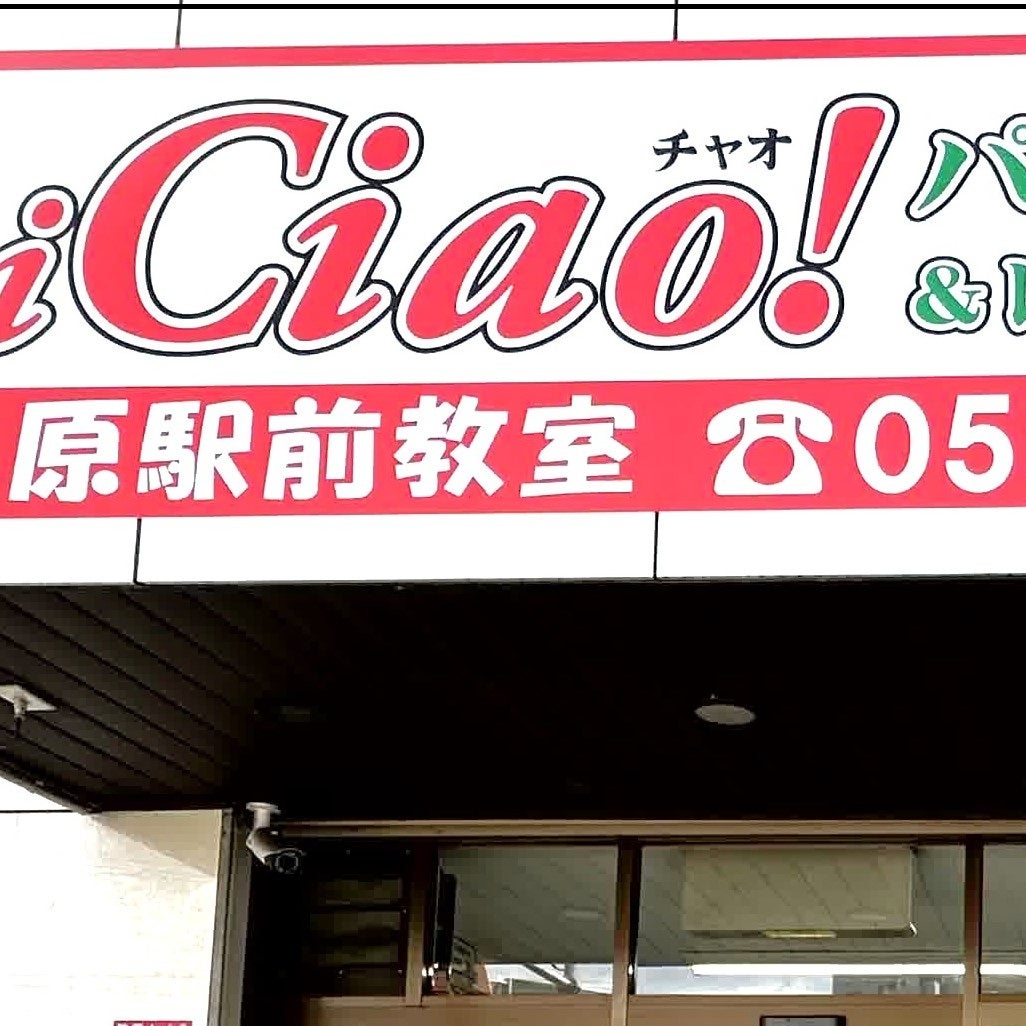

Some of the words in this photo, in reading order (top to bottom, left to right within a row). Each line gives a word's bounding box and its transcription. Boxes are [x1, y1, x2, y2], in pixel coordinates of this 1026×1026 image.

[653, 127, 793, 171] チャオ
[6, 396, 637, 503] 原駅前教室
